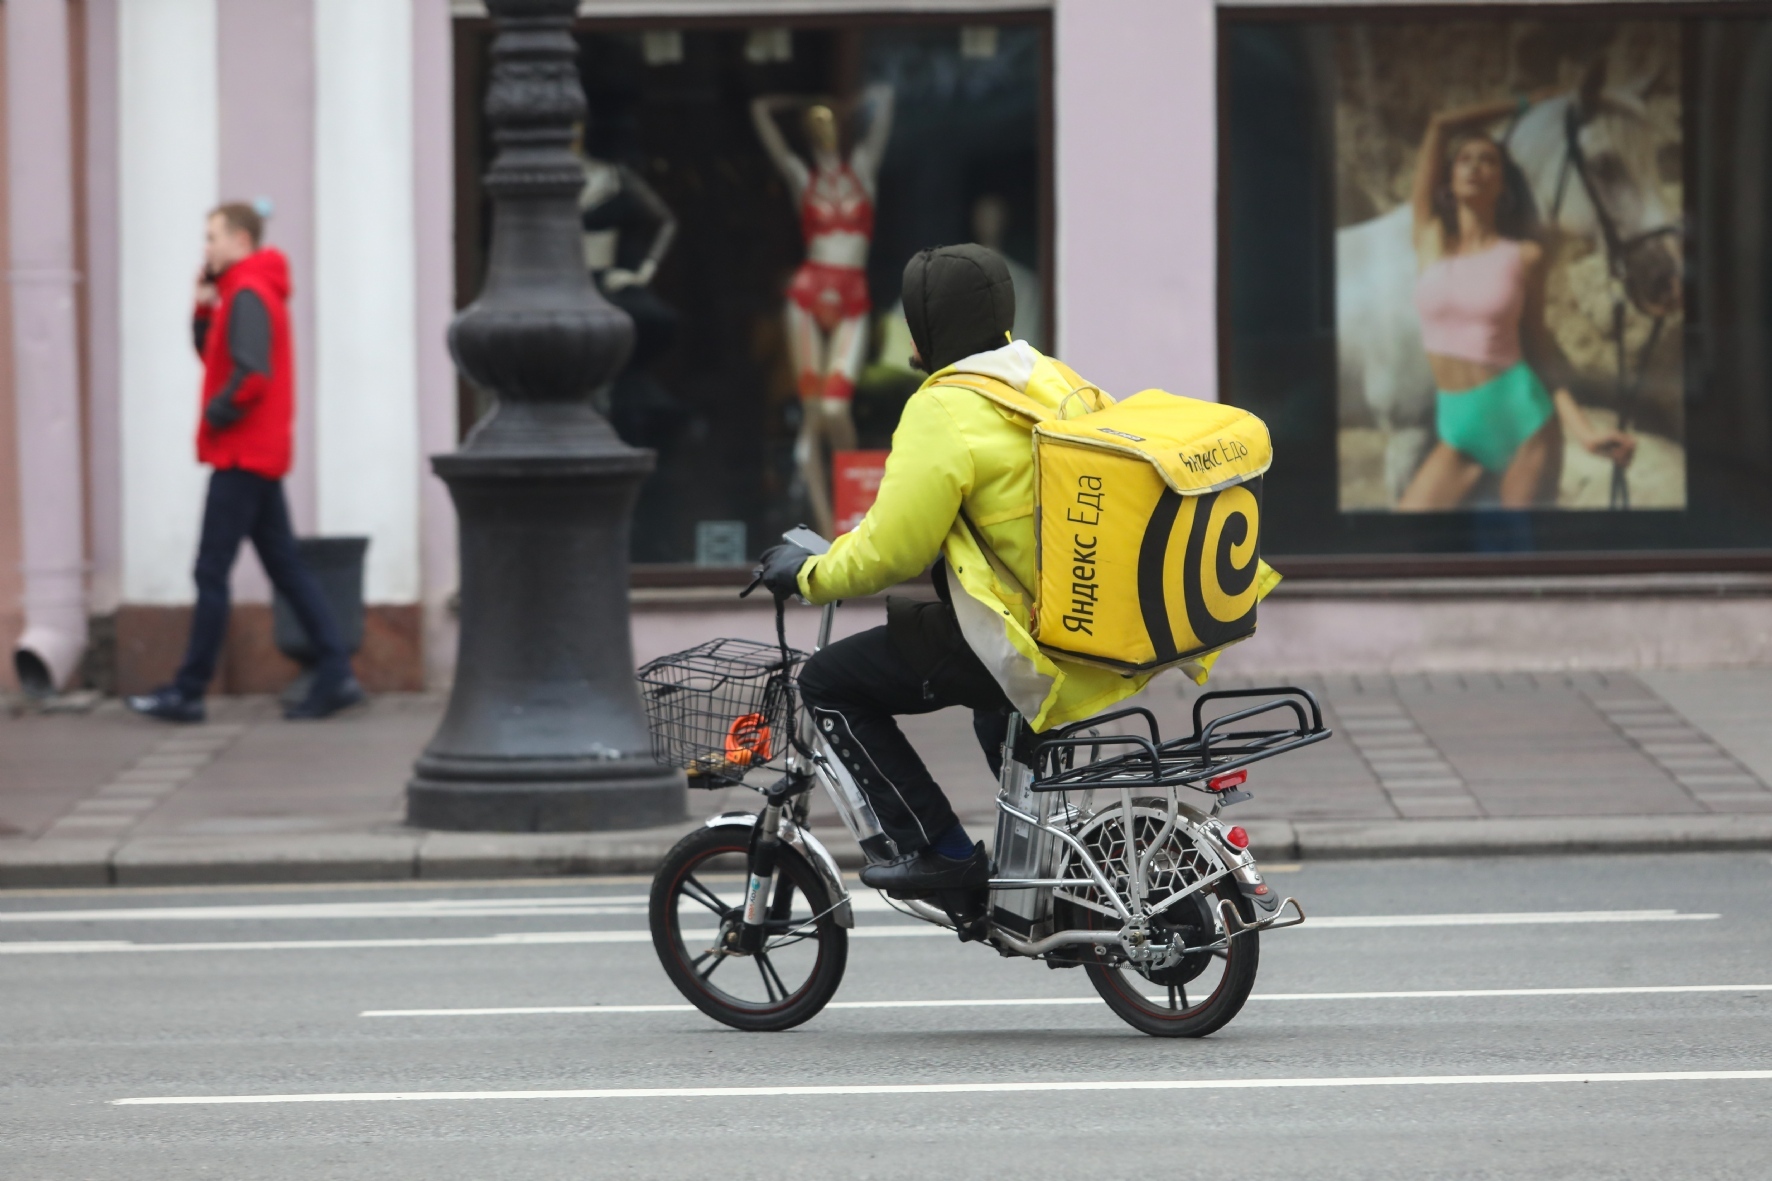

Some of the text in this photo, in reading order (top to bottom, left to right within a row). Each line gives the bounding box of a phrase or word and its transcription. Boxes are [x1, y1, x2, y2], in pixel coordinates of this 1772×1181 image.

[1179, 438, 1248, 473] Яндекс Еда
[1062, 475, 1105, 636] Яндекс Еда
